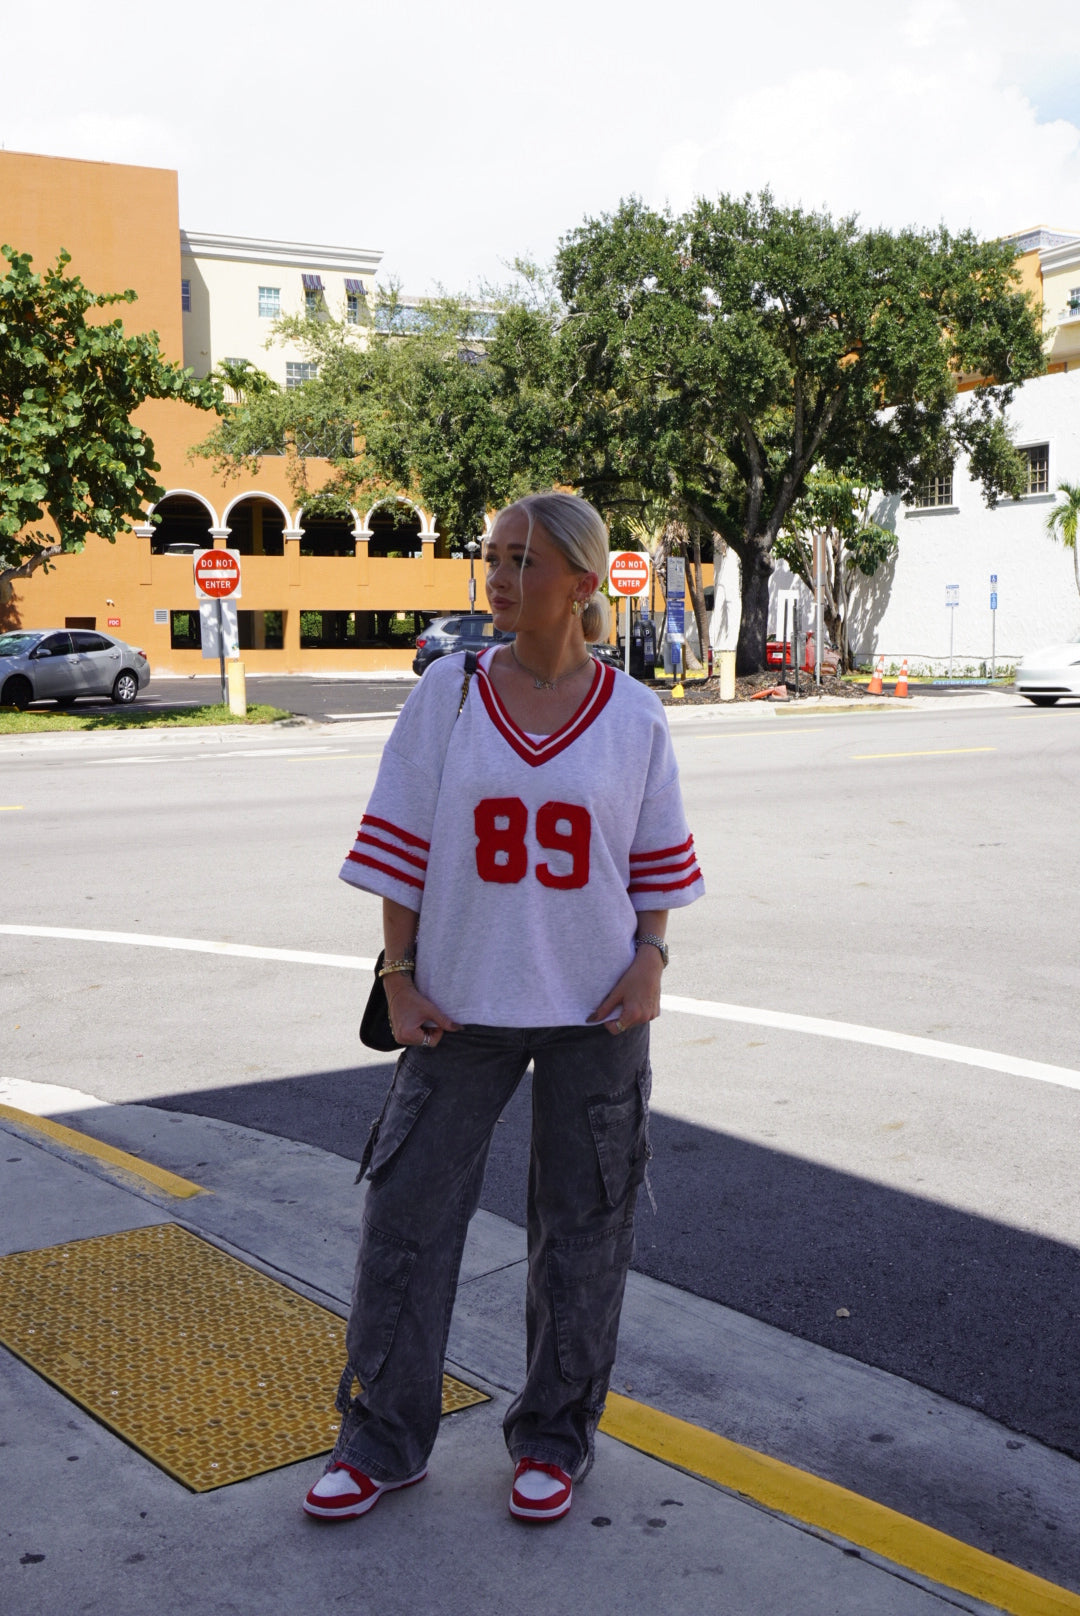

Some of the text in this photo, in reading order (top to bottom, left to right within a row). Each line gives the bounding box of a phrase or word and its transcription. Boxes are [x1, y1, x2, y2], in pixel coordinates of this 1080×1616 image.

[201, 559, 233, 568] DO NOT
[615, 560, 643, 568] DO NOT
[205, 580, 231, 589] ENTER
[473, 796, 591, 890] 89
